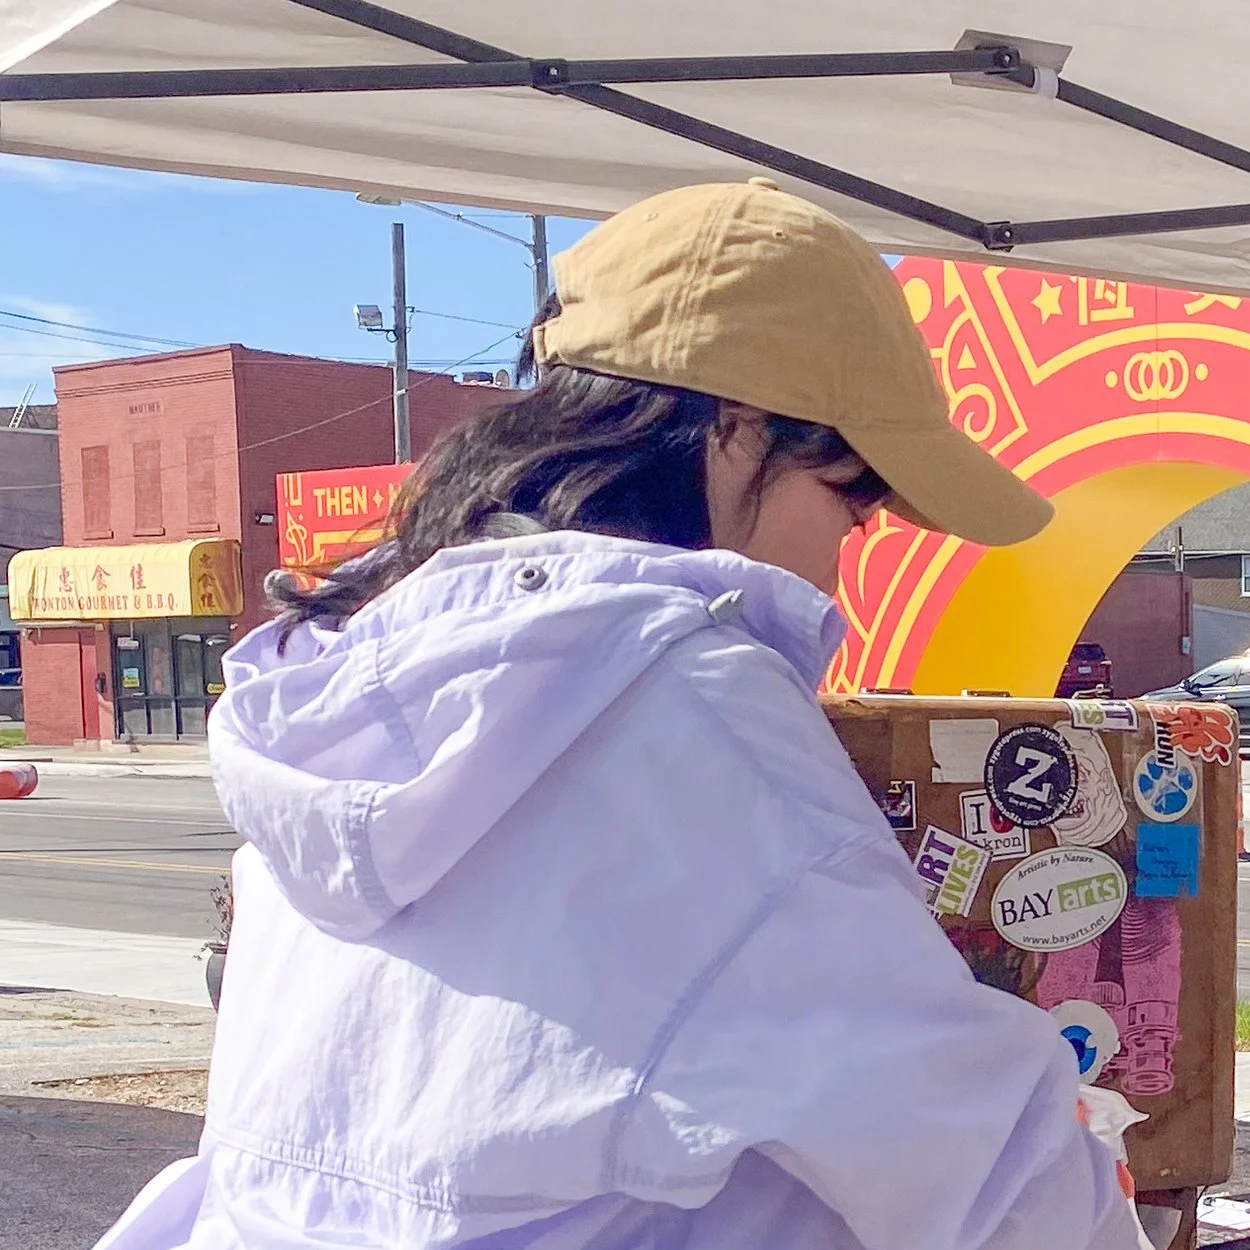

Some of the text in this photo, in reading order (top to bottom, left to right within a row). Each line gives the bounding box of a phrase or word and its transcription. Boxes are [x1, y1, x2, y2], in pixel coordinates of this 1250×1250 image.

[313, 485, 368, 518] THEN
[78, 595, 129, 611] GOURMET
[1004, 745, 1058, 804] Z
[969, 803, 987, 835] I
[917, 831, 956, 888] RT
[975, 836, 1022, 852] kron
[935, 845, 979, 915] LIVES
[1017, 853, 1094, 881] Artistic by Nature
[998, 877, 1116, 927] BAY arts
[1022, 915, 1107, 946] www.bayarts.net
